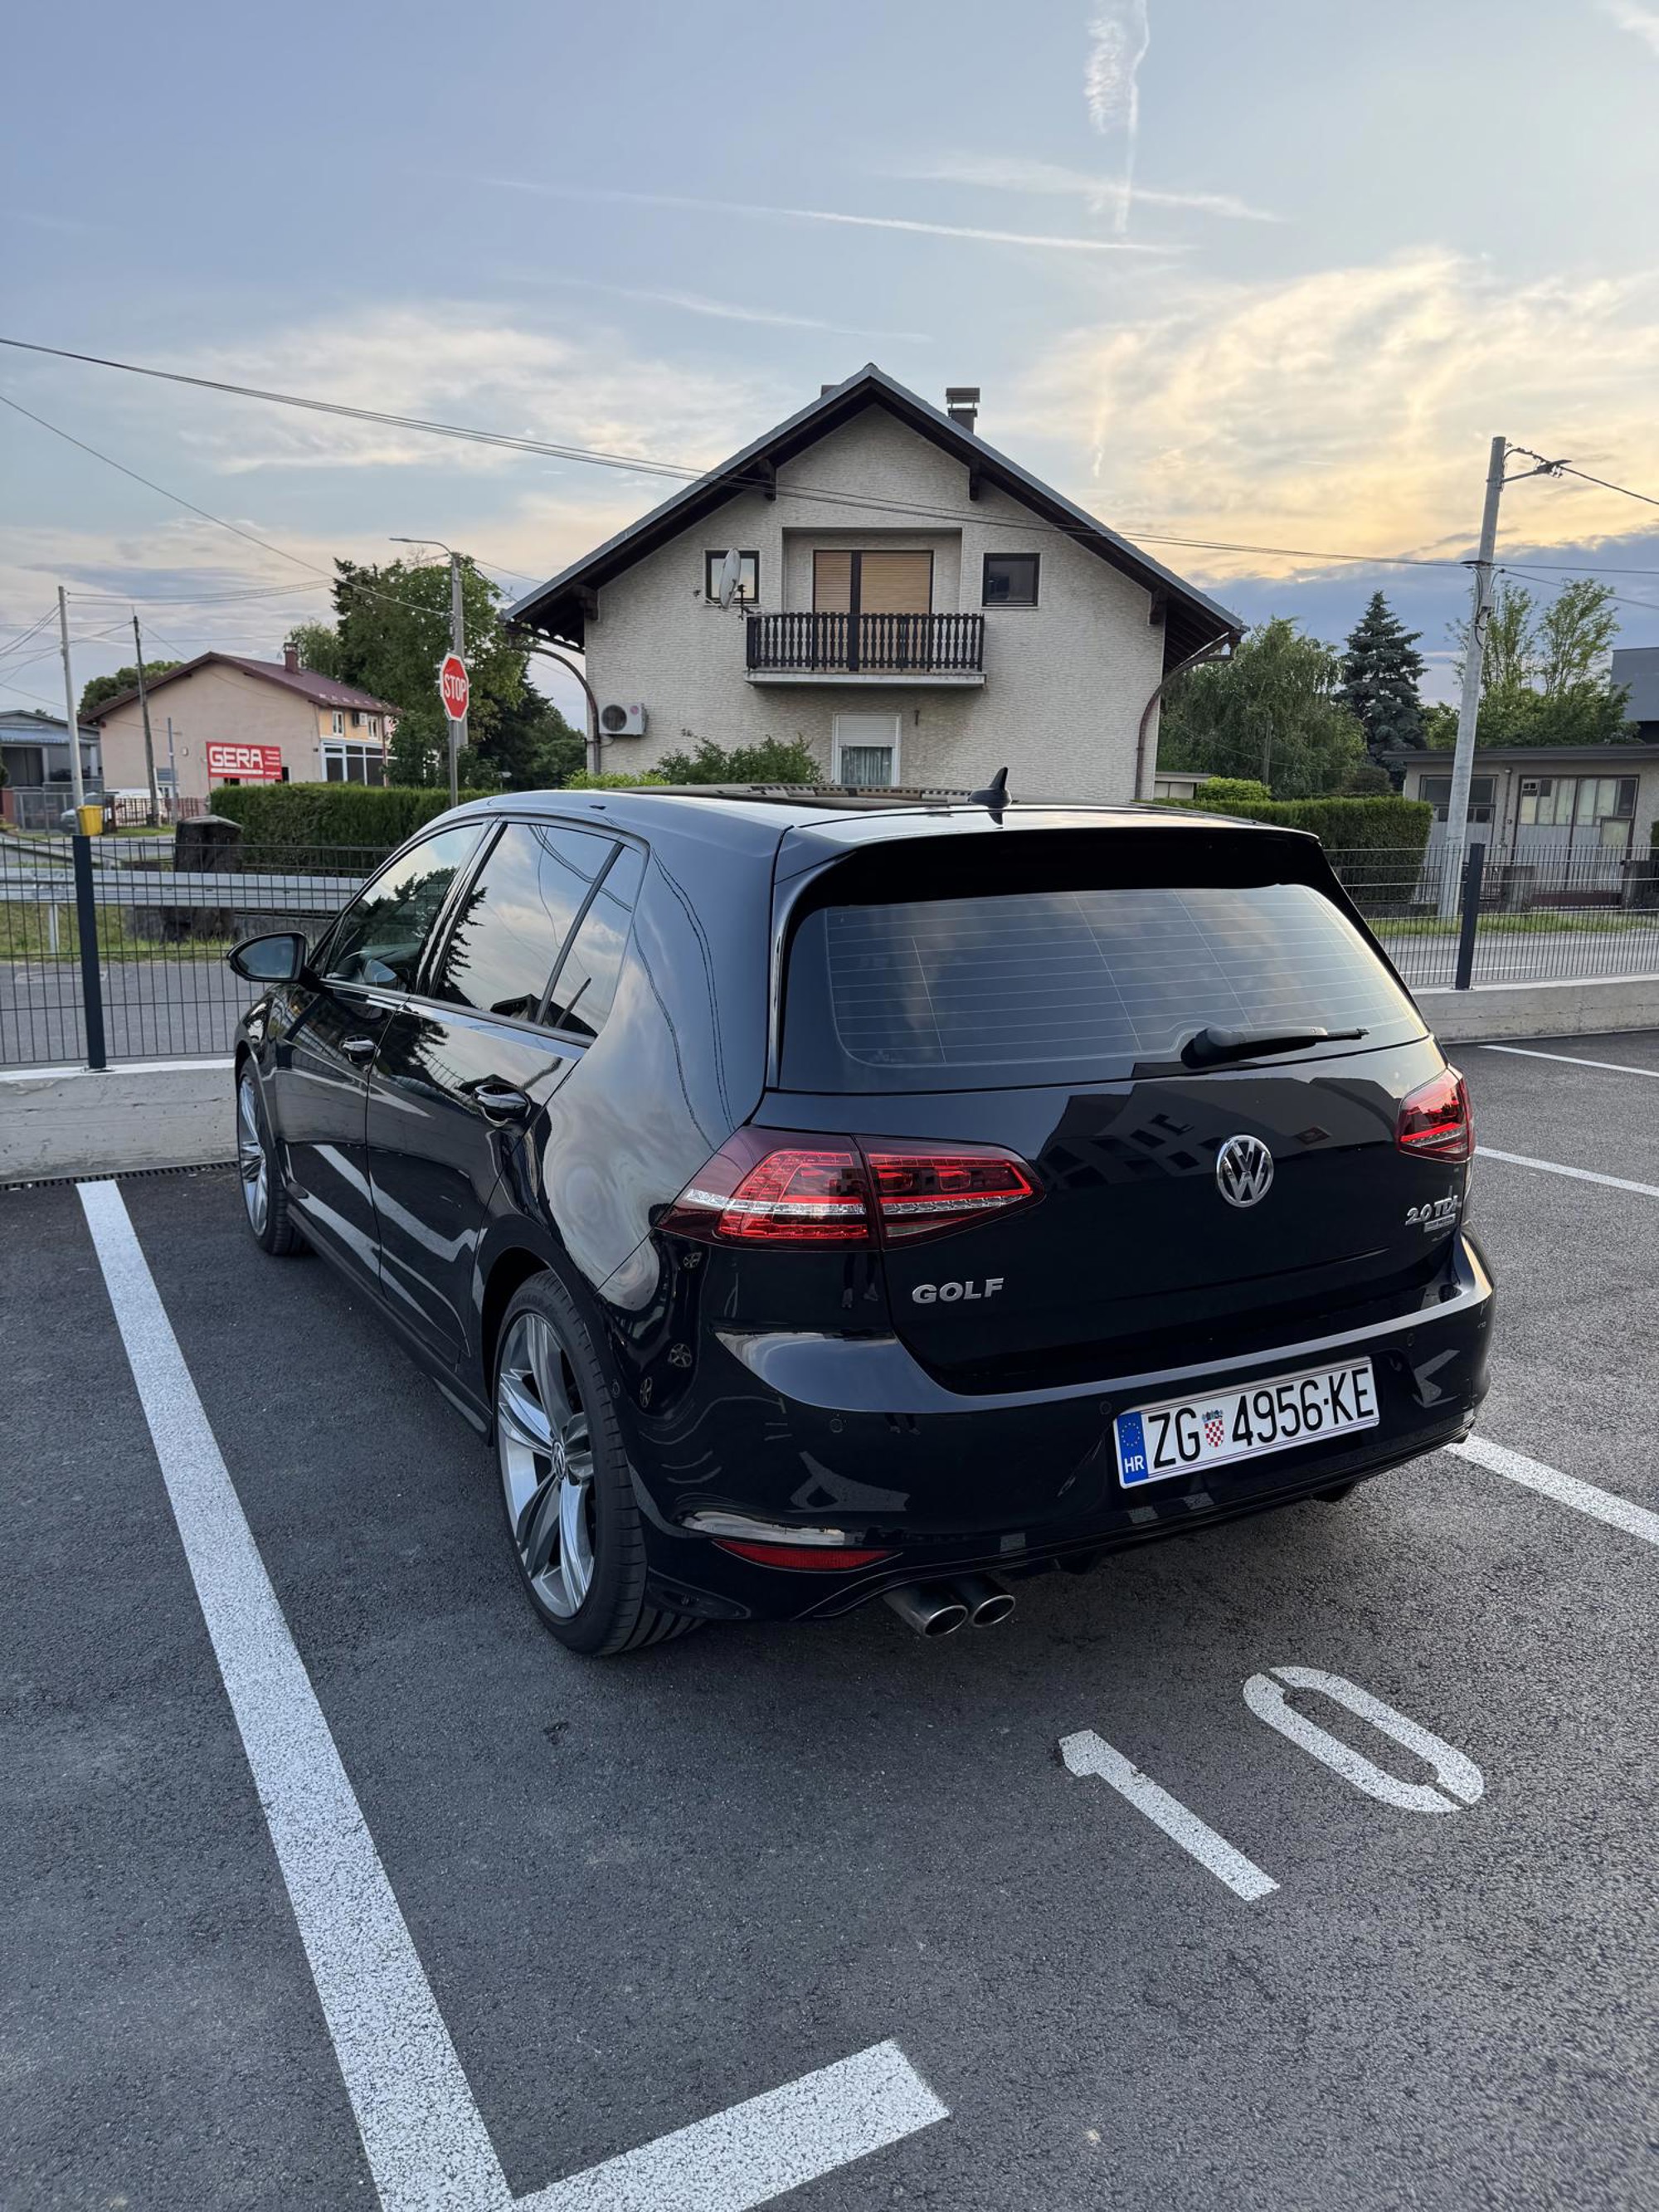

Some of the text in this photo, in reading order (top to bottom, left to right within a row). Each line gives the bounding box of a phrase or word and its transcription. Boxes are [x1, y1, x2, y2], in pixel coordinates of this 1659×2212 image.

[444, 673, 466, 702] STOP
[209, 746, 264, 769] GERA
[912, 1278, 1005, 1304] GOLF
[1147, 1407, 1201, 1469] ZG
[1124, 1455, 1145, 1474] HR
